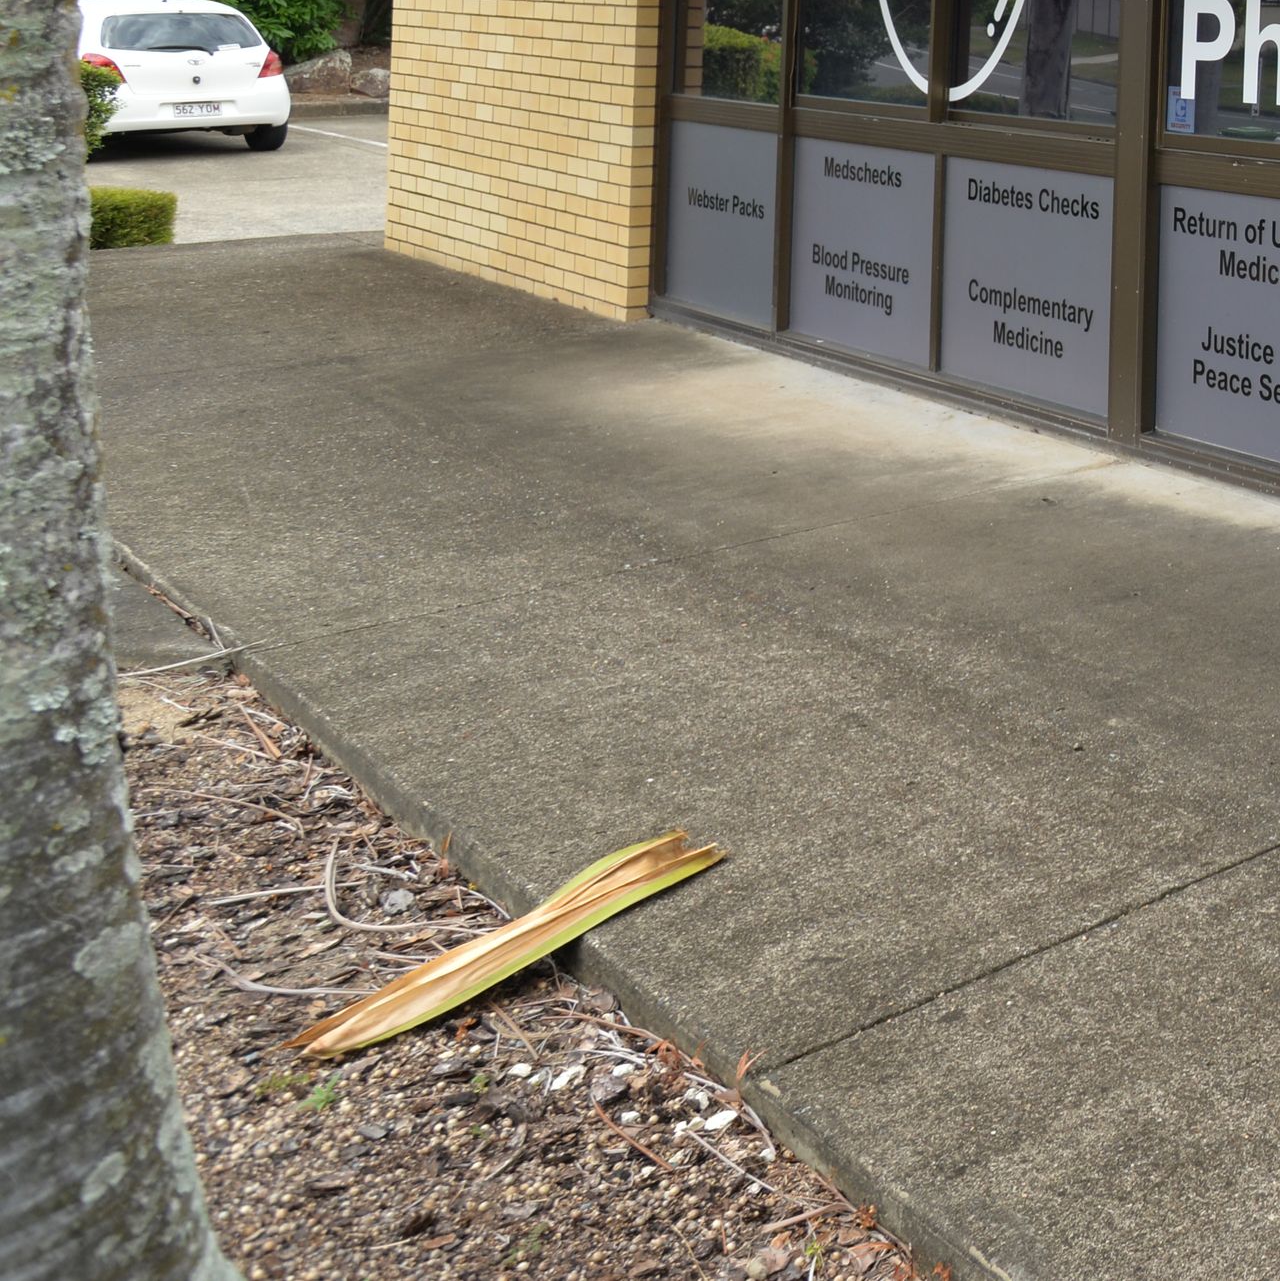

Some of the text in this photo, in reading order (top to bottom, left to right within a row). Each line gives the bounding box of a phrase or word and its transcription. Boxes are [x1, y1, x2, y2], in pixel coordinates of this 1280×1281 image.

[175, 105, 195, 115] 562
[824, 156, 902, 188] Medschecks
[688, 188, 765, 220] Webster Packs
[967, 178, 1100, 220] Diabetes Checks
[1173, 207, 1237, 242] Return
[1244, 218, 1265, 245] of
[812, 243, 910, 286] Blood Pressure
[825, 274, 894, 316] Monitoring
[968, 278, 1094, 332] Complementary
[992, 320, 1066, 359] Medicine
[1200, 326, 1274, 366] Justice
[1192, 358, 1252, 397] Peace
